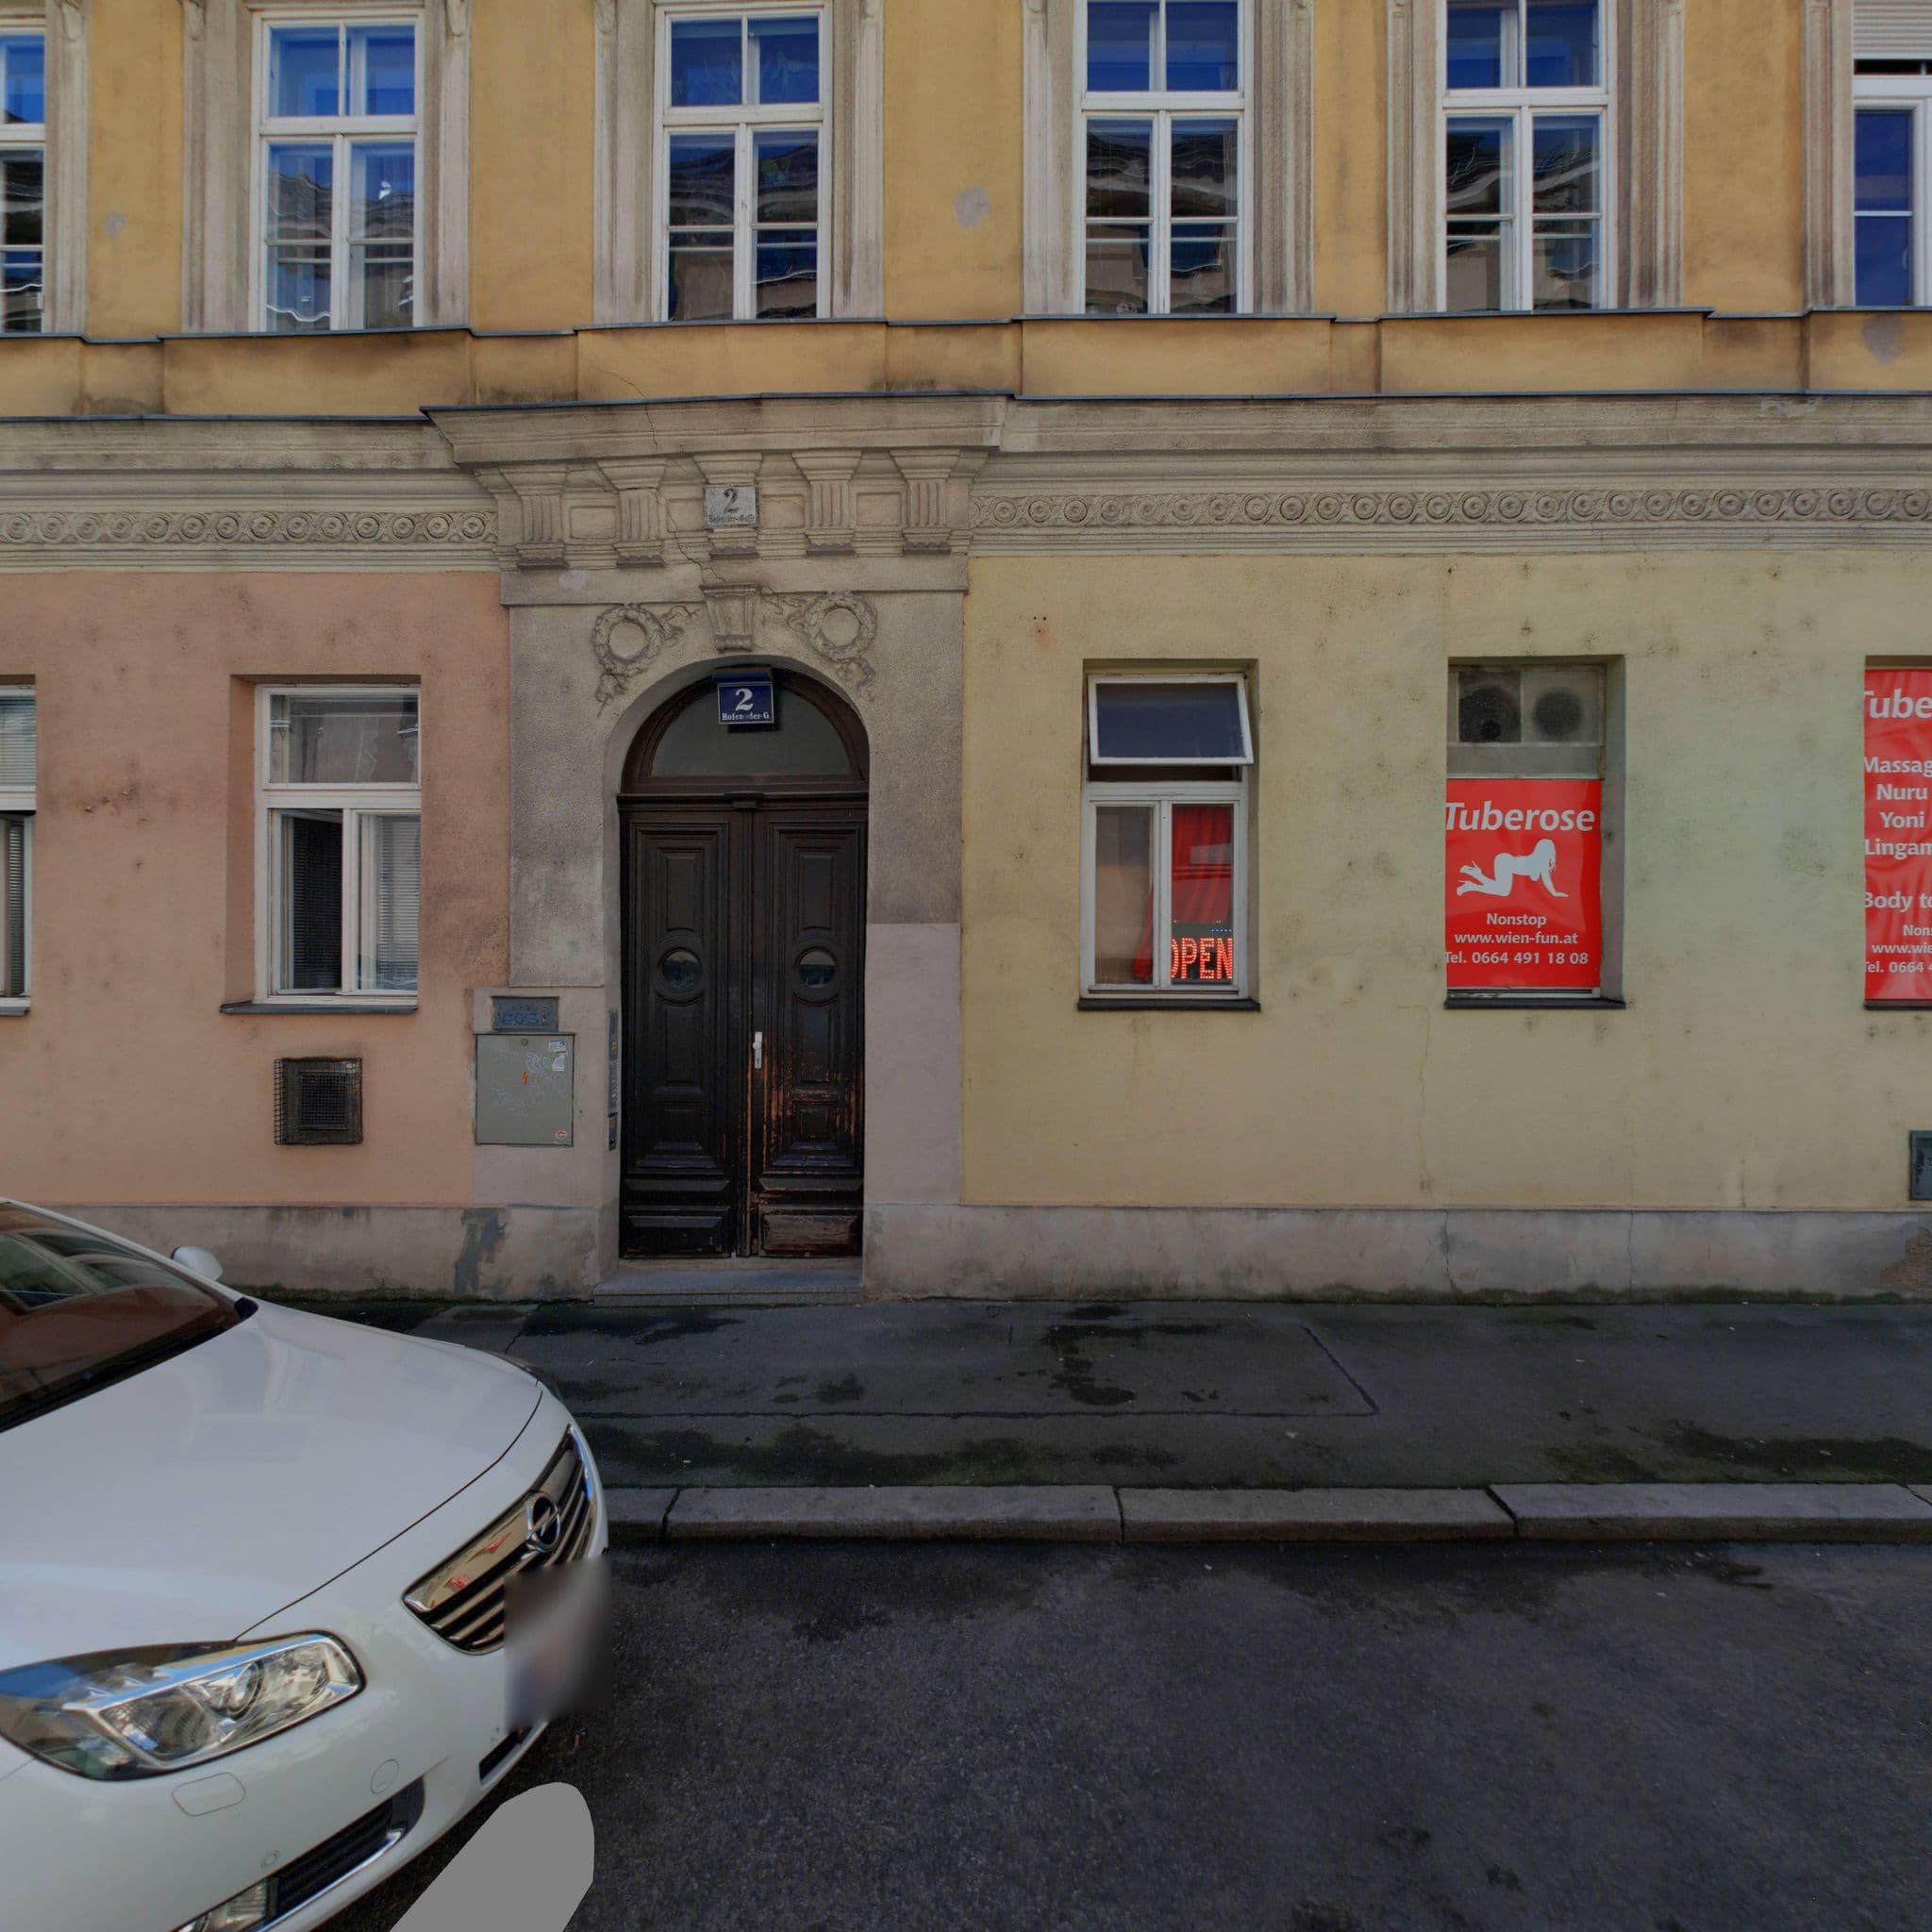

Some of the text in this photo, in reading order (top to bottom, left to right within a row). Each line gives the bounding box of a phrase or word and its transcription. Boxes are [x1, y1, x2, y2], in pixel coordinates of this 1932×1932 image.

[724, 488, 740, 513] 2
[735, 688, 754, 711] 2
[1876, 783, 1928, 800] Nuru
[1445, 800, 1595, 832] Tuberose
[1879, 810, 1925, 828] Yoni
[1864, 891, 1913, 912] Body
[1487, 913, 1547, 926] Nonstop
[1455, 931, 1578, 944] www.wien-fun.at
[1902, 924, 1932, 936] Non
[1444, 951, 1589, 964] Tel. 0664 491 18 08
[1889, 961, 1924, 973] 0664
